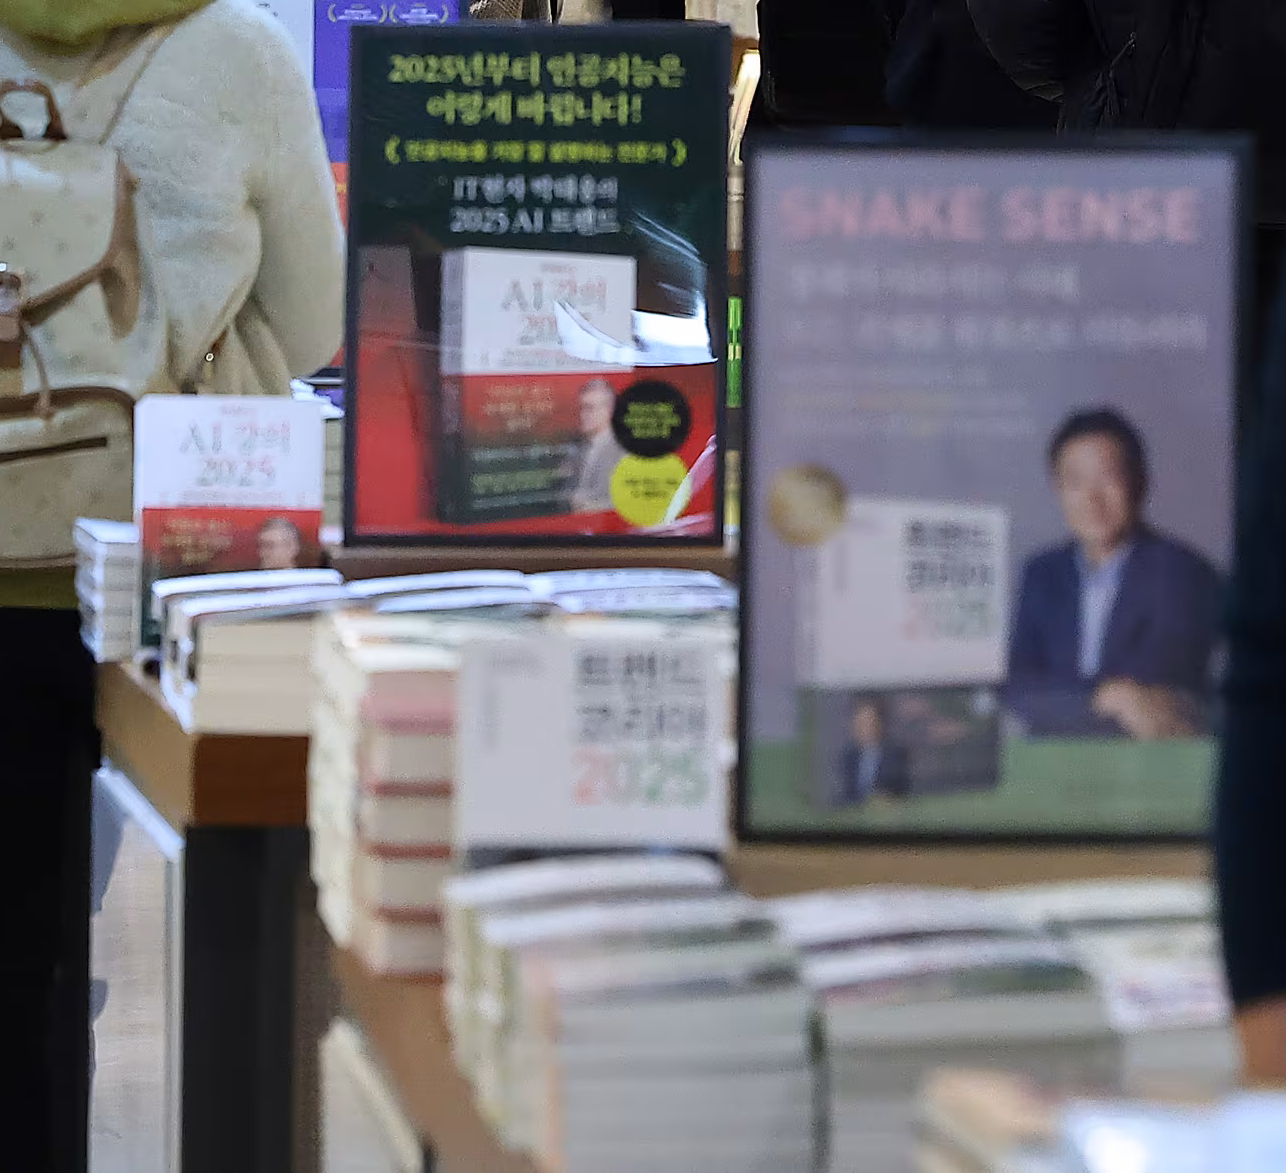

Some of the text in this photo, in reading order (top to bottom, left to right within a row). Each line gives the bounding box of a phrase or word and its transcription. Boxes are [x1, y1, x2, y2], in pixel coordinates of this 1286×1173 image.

[388, 51, 541, 87] 2025년부터
[779, 186, 1201, 243] SNAKE SENSE
[572, 750, 710, 807] 2025
